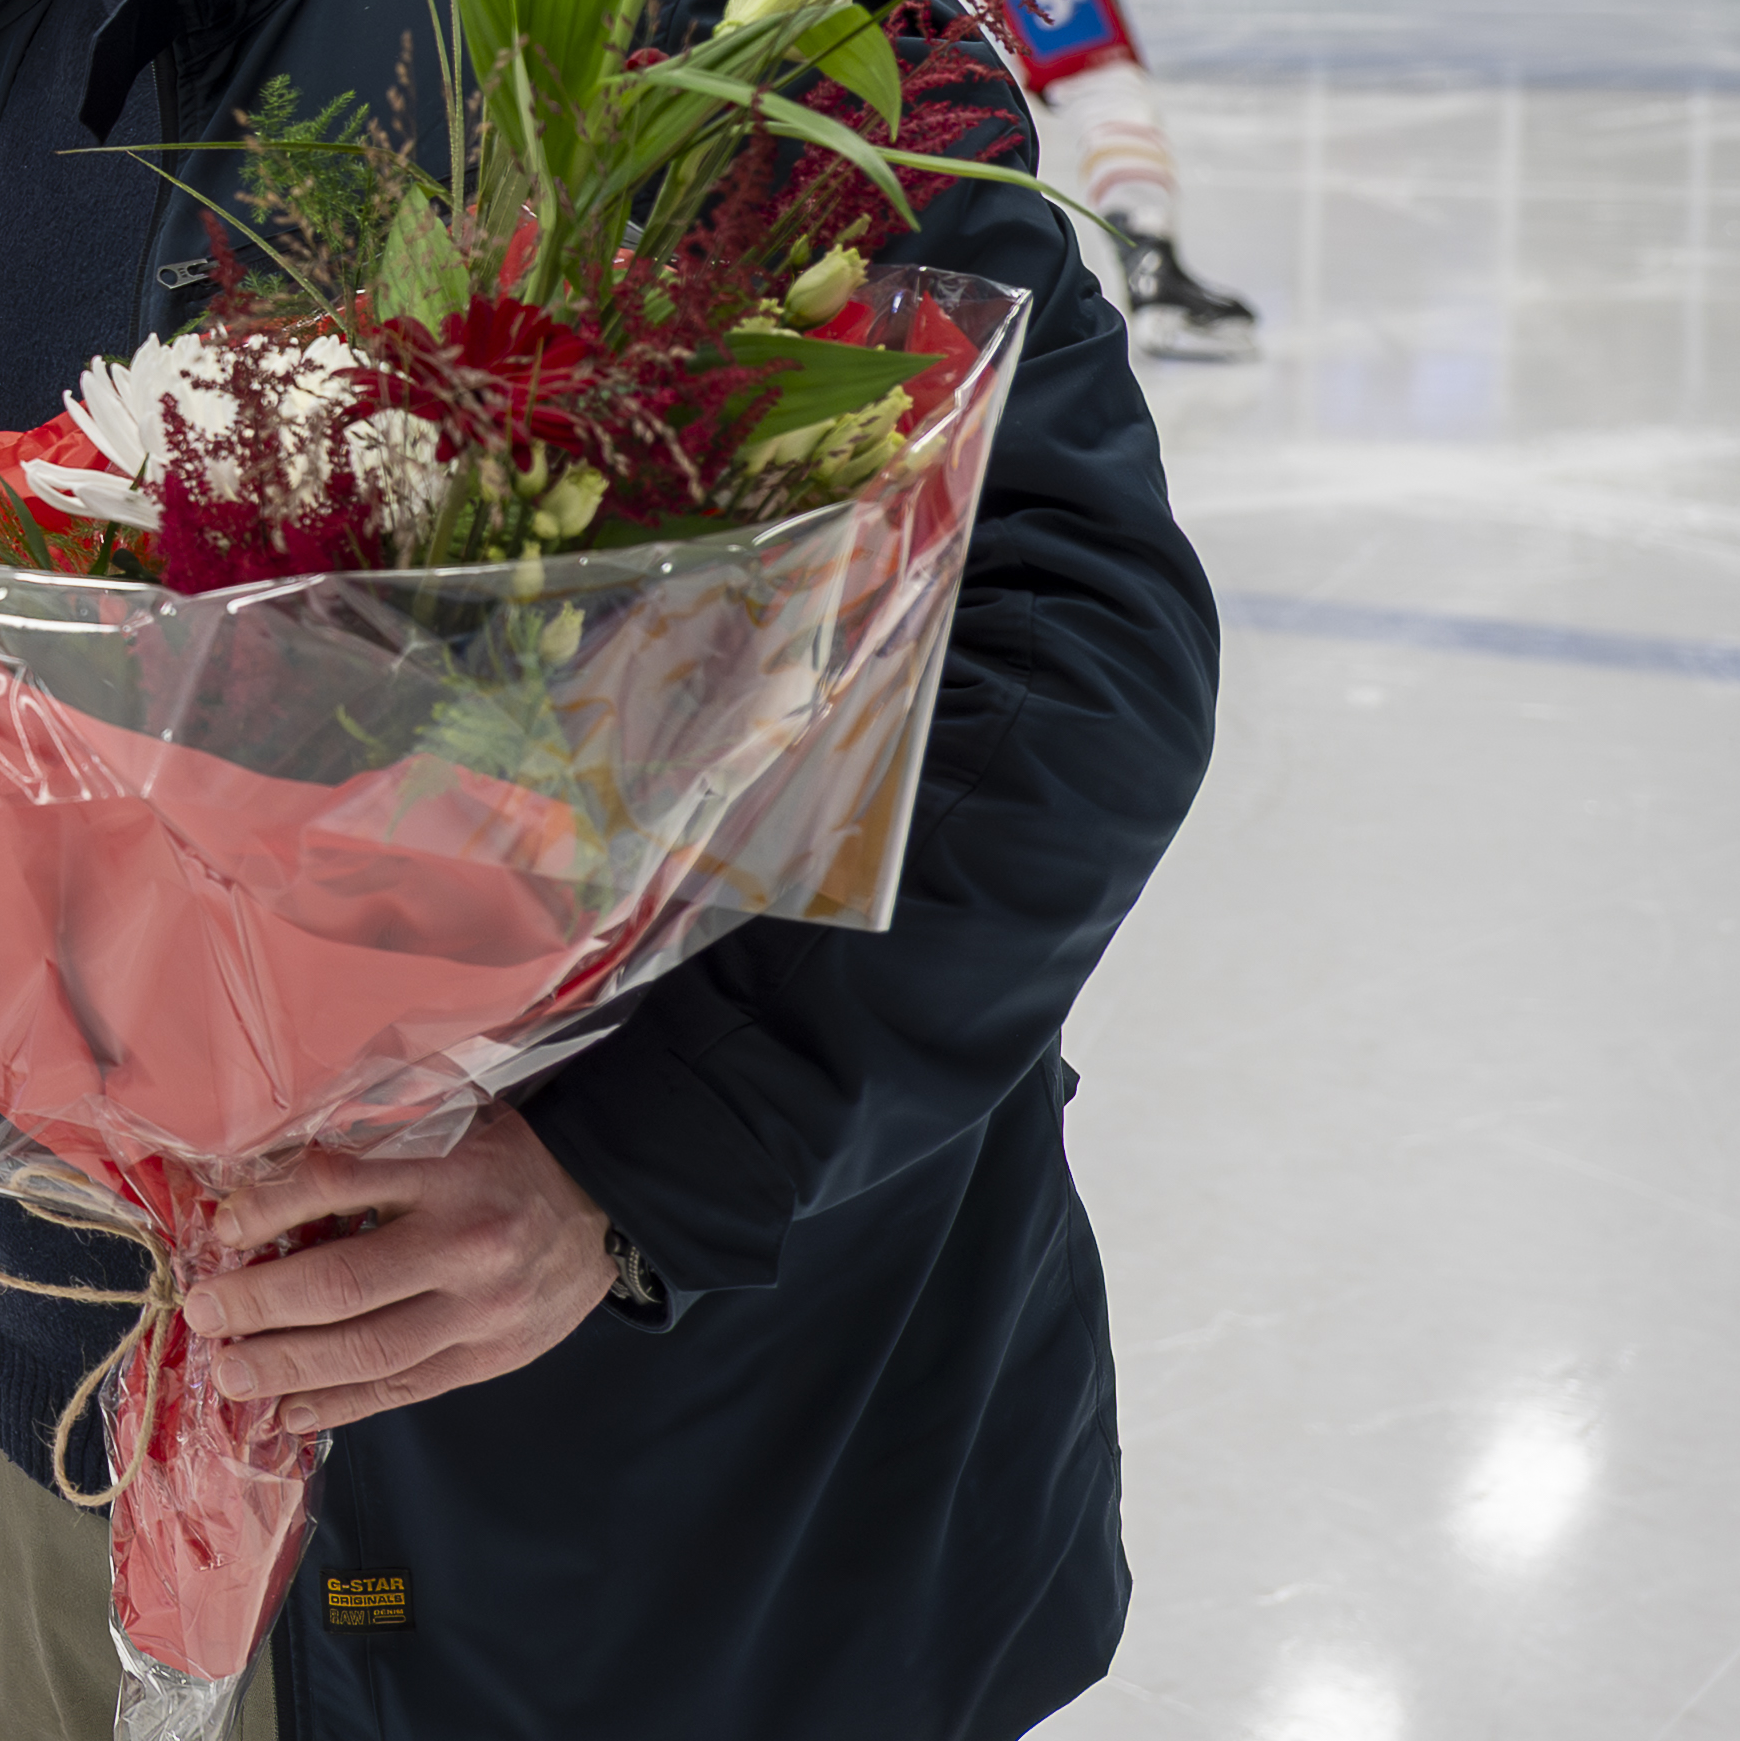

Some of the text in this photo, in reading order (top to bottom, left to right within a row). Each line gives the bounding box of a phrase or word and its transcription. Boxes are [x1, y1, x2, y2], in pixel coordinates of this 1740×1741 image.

[327, 1577, 405, 1593] G-STAR
[331, 1595, 403, 1605] ORIGINALS
[329, 1608, 365, 1625] RAW
